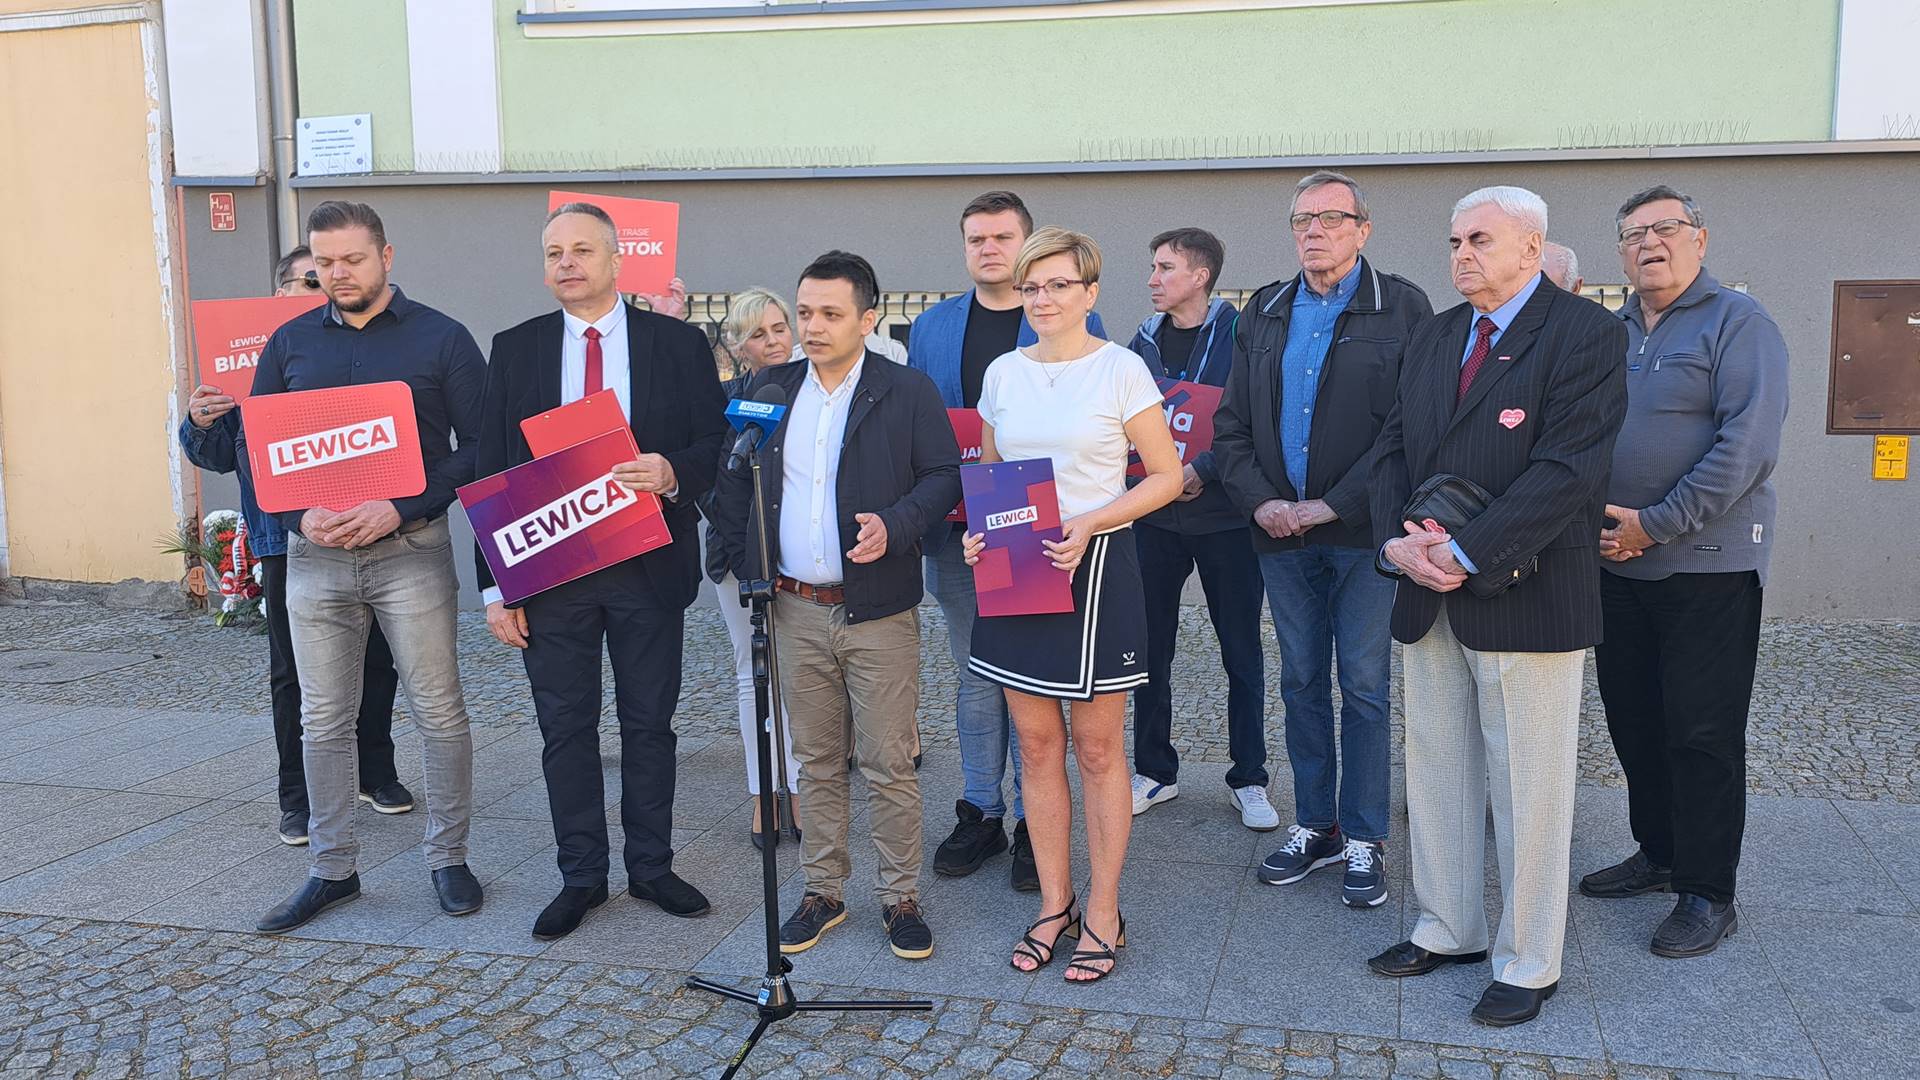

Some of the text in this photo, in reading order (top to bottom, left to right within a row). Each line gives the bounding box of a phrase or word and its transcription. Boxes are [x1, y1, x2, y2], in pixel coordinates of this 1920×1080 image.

[230, 334, 268, 349] LEWICA
[276, 423, 391, 469] LEWICA
[503, 478, 629, 557] LEWICA
[989, 508, 1035, 527] LEWICA
